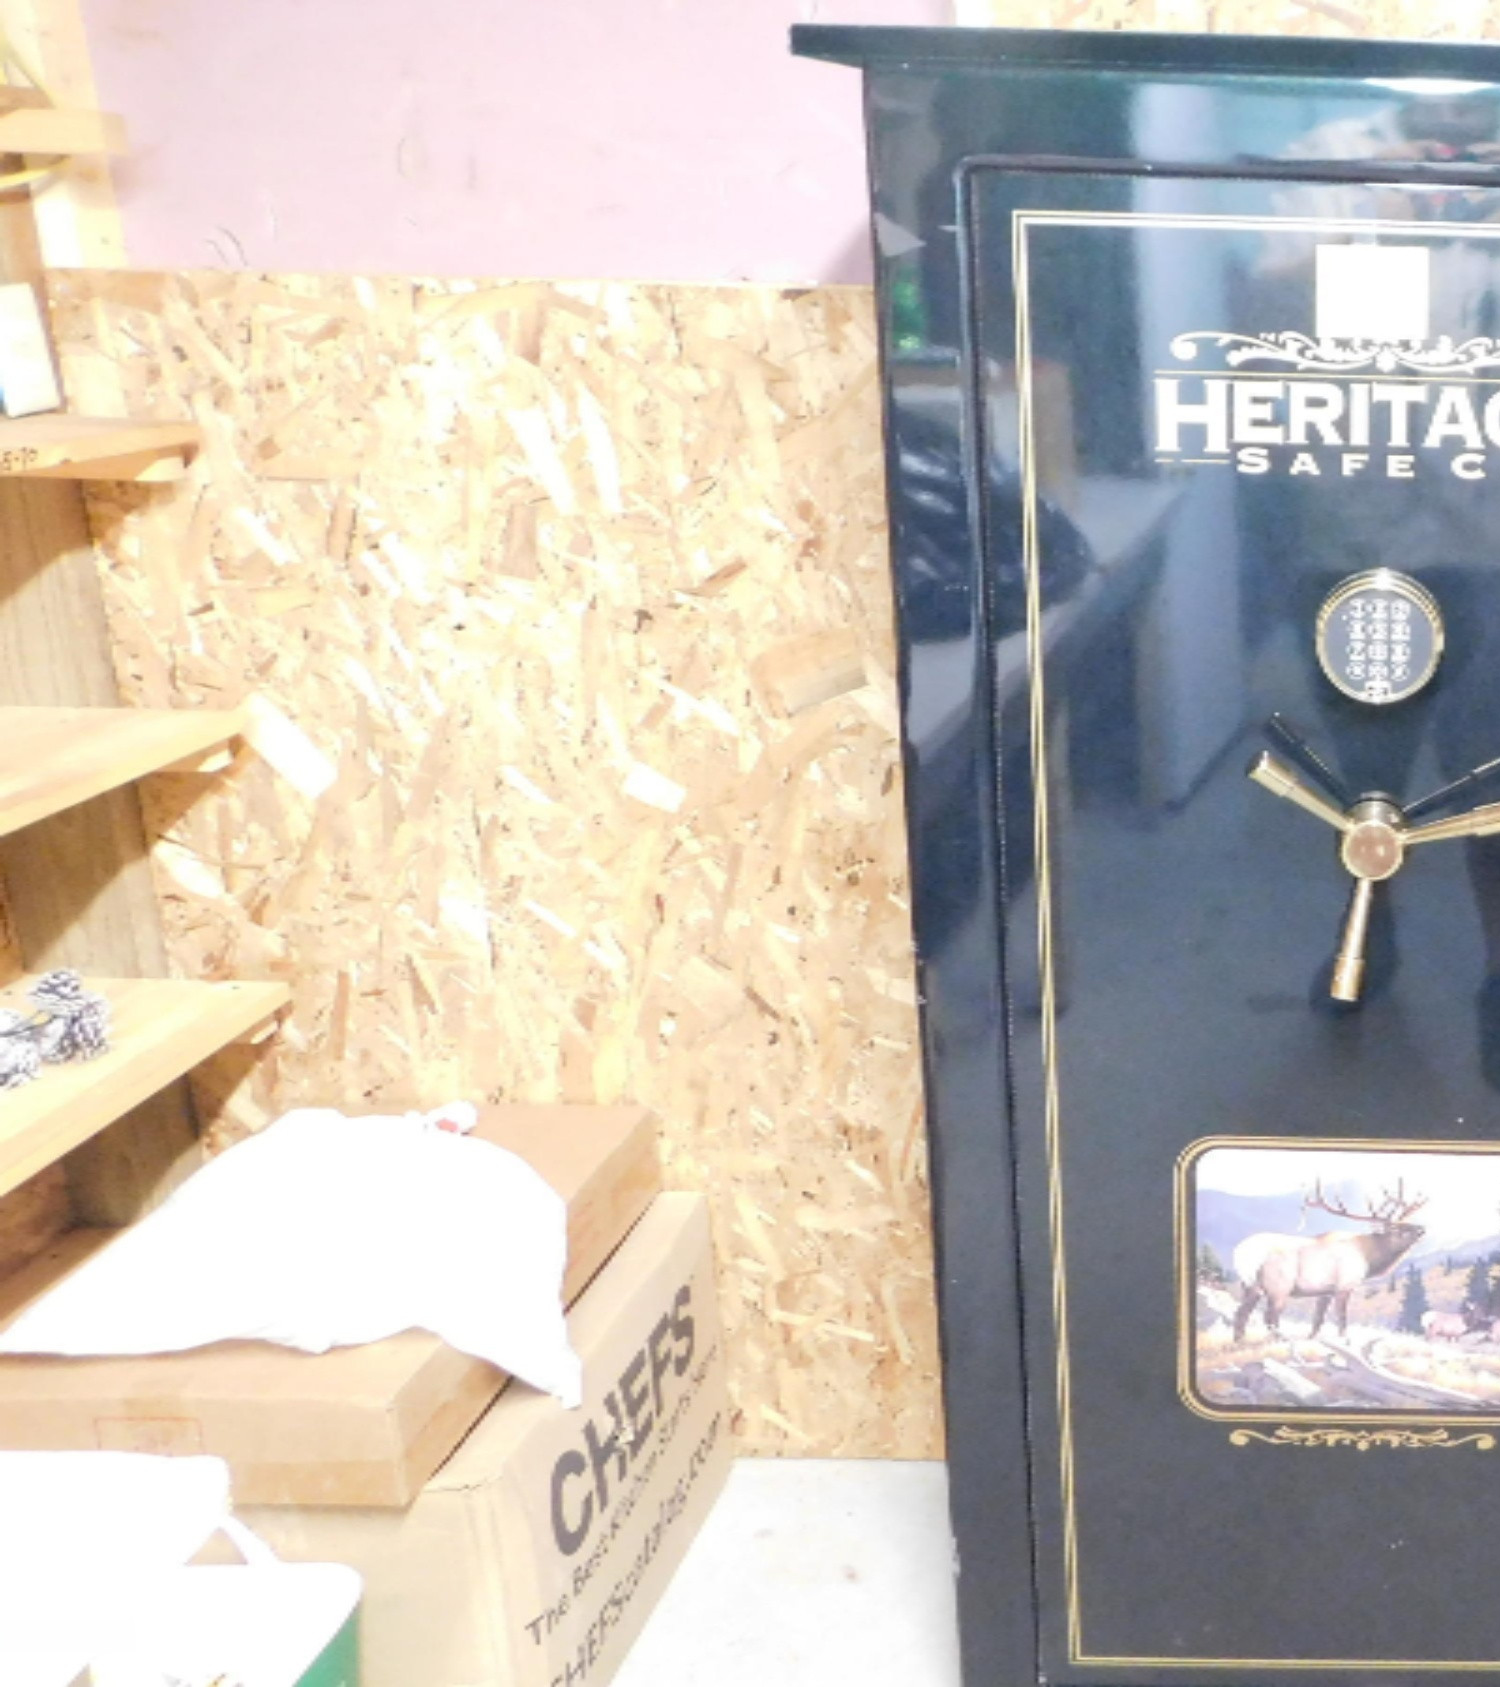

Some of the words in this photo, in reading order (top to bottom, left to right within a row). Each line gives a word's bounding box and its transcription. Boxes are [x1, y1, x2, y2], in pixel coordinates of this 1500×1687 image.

[1236, 447, 1415, 479] SAFE
[550, 1284, 695, 1556] CHEFS
[524, 1592, 570, 1646] The
